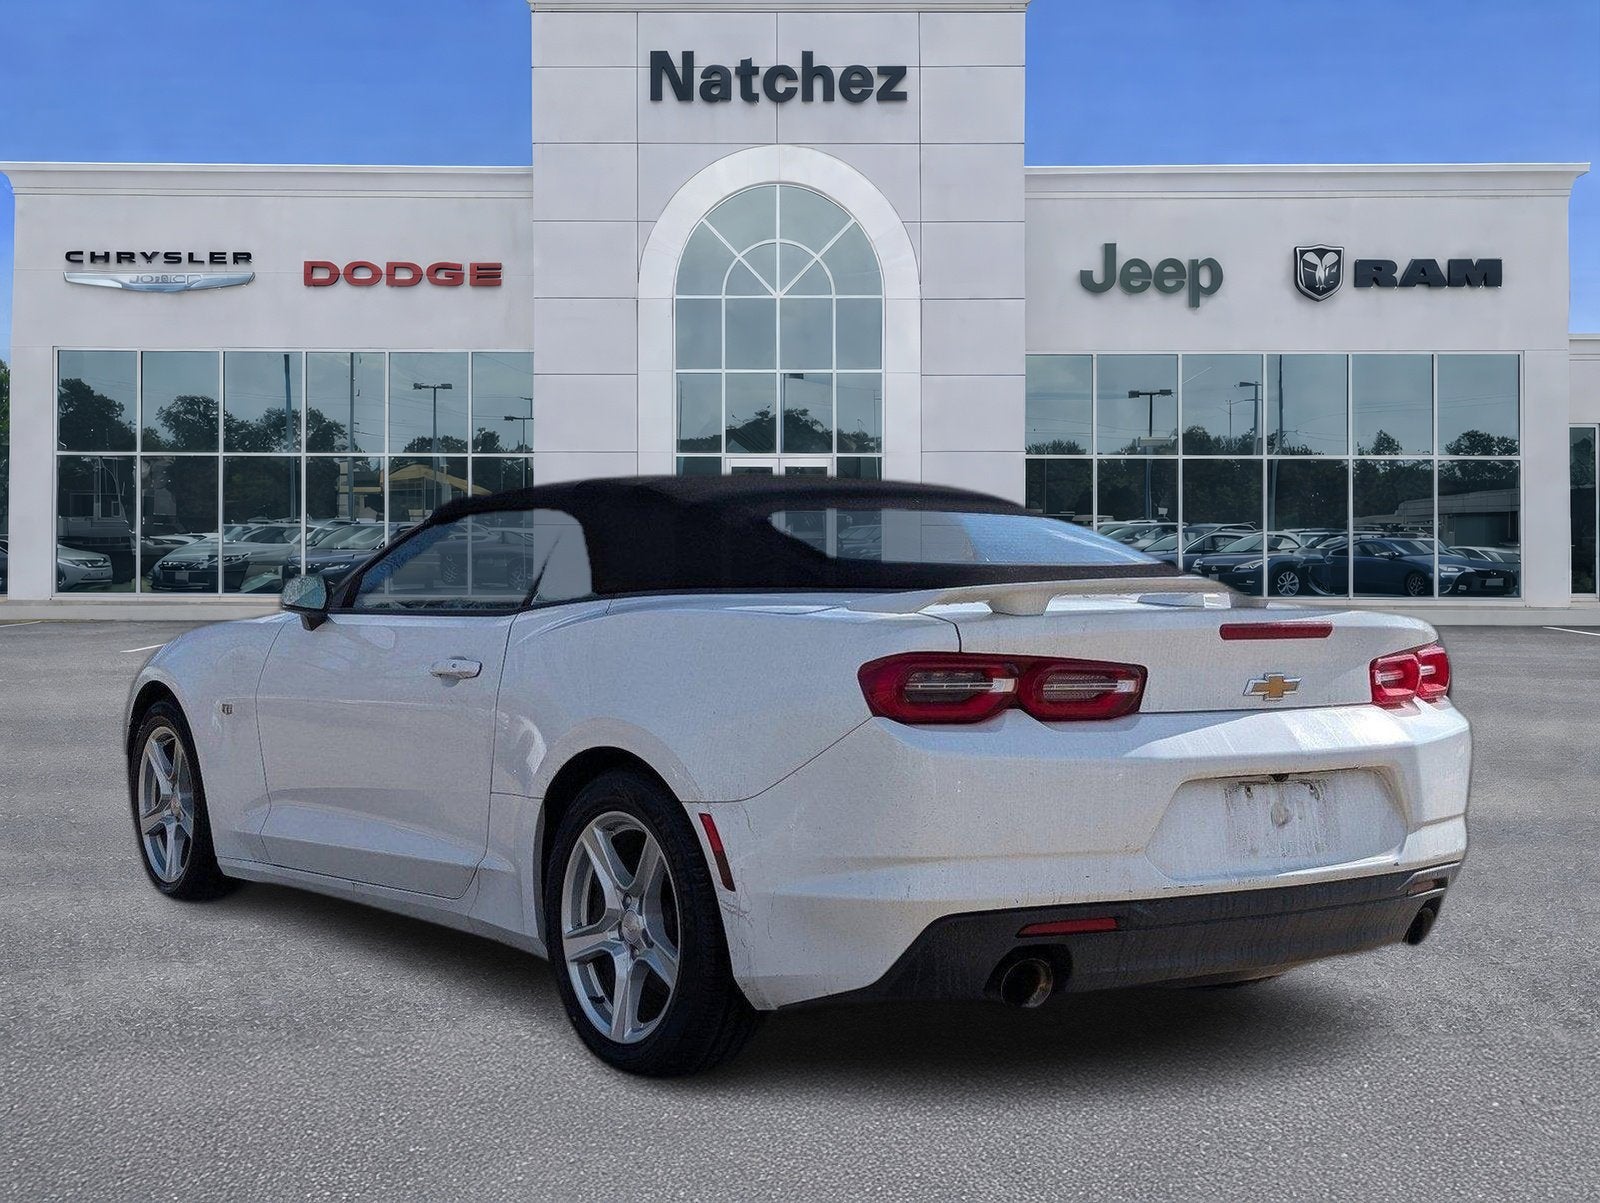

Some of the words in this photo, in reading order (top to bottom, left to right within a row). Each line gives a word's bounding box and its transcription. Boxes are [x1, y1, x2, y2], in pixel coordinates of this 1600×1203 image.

[649, 50, 908, 106] Natchez
[64, 250, 253, 265] CHRYSLER
[1353, 257, 1503, 289] RAM
[303, 260, 503, 289] DODGE
[1079, 242, 1224, 309] Jeep
